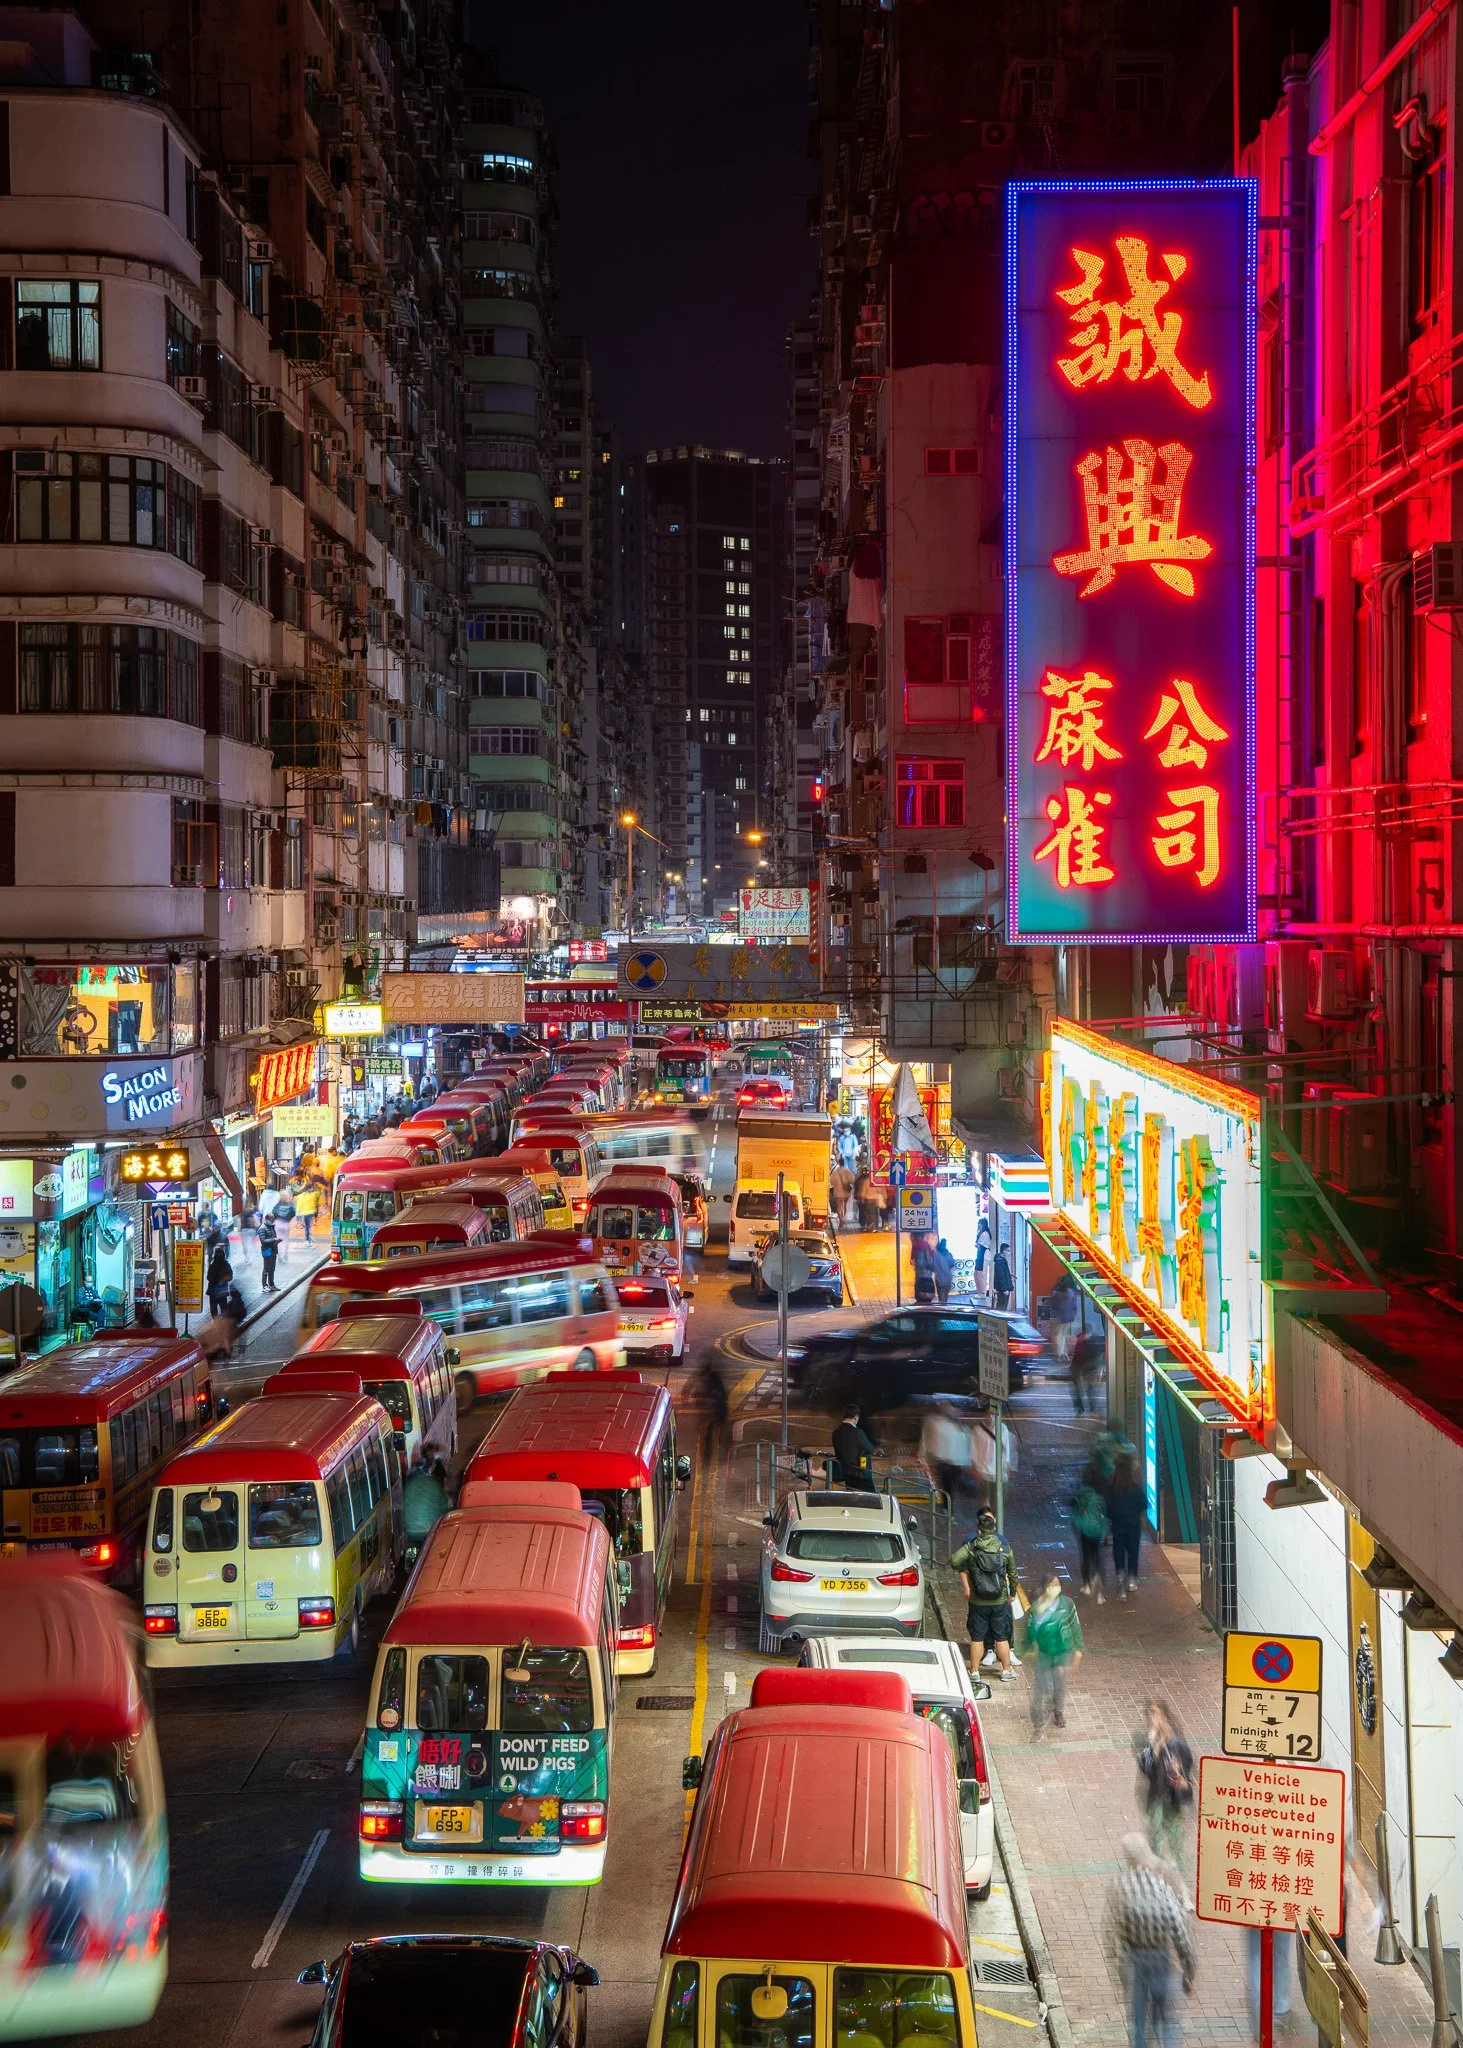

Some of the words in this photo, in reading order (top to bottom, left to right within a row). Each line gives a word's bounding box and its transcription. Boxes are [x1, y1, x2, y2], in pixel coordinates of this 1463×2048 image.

[1053, 236, 1213, 597] 誠興
[1144, 679, 1228, 886] 公司
[103, 1067, 167, 1104] SALON
[128, 1088, 182, 1121] MORE
[124, 1154, 187, 1177] 海天堂
[916, 1208, 929, 1217] hrs
[907, 1218, 926, 1227] 全日
[823, 1581, 836, 1589] YD
[840, 1580, 866, 1590] 7356
[205, 1610, 219, 1618] EP
[197, 1618, 227, 1627] 3880
[1247, 1691, 1263, 1700] am
[1241, 1703, 1268, 1716] 上午
[1285, 1697, 1300, 1718] 7
[1230, 1726, 1279, 1738] midnight
[418, 1738, 462, 1764] 唔好
[500, 1739, 548, 1753] DON'T
[552, 1738, 590, 1752] FEED
[1240, 1739, 1267, 1752] 午夜
[1286, 1735, 1313, 1756] 12
[500, 1757, 539, 1771] WILD
[543, 1757, 576, 1771] PIGS
[1244, 1769, 1300, 1787] Vehicle
[1216, 1785, 1273, 1802] waiting
[1278, 1791, 1305, 1806] will
[1310, 1793, 1328, 1807] be
[441, 1810, 458, 1821] FP
[1227, 1803, 1315, 1823] prosecuted
[435, 1821, 463, 1832] 693
[1207, 1819, 1267, 1836] without
[1272, 1827, 1335, 1845] warning
[1226, 1840, 1315, 1868] 停車等候
[467, 1865, 524, 1877] 撞得碎碎
[1226, 1869, 1314, 1896] 會被檢控
